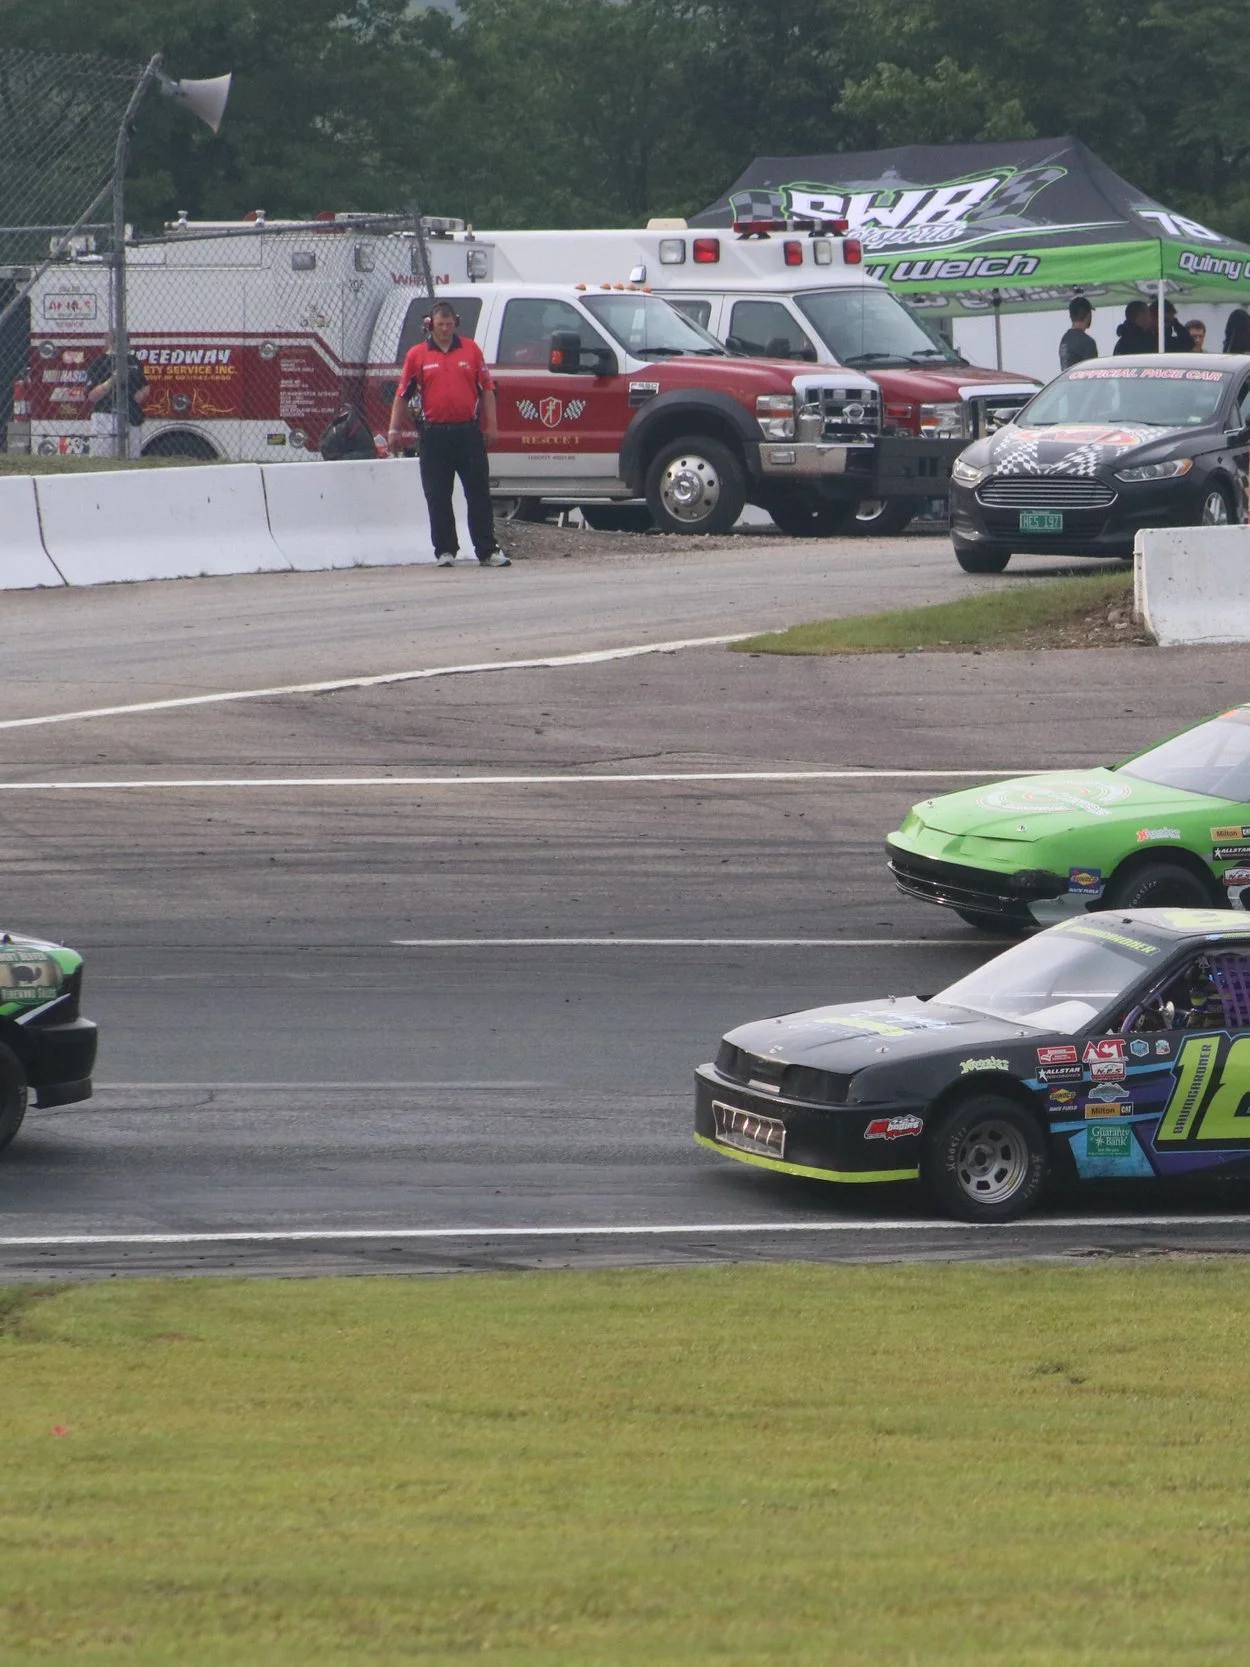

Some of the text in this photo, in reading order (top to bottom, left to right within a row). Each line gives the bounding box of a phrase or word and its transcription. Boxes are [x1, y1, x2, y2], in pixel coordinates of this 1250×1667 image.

[891, 253, 1041, 283] Welch
[1179, 251, 1241, 281] Quinny
[166, 365, 212, 375] SERVICE
[1069, 368, 1224, 382] OFFICIAL PACE CAR
[1216, 829, 1238, 838] Milton
[1045, 1067, 1081, 1075] ALLSTAR
[1090, 1105, 1132, 1115] Milton CAT
[1091, 1125, 1131, 1138] Guaranty
[1105, 1136, 1127, 1147] Bank
